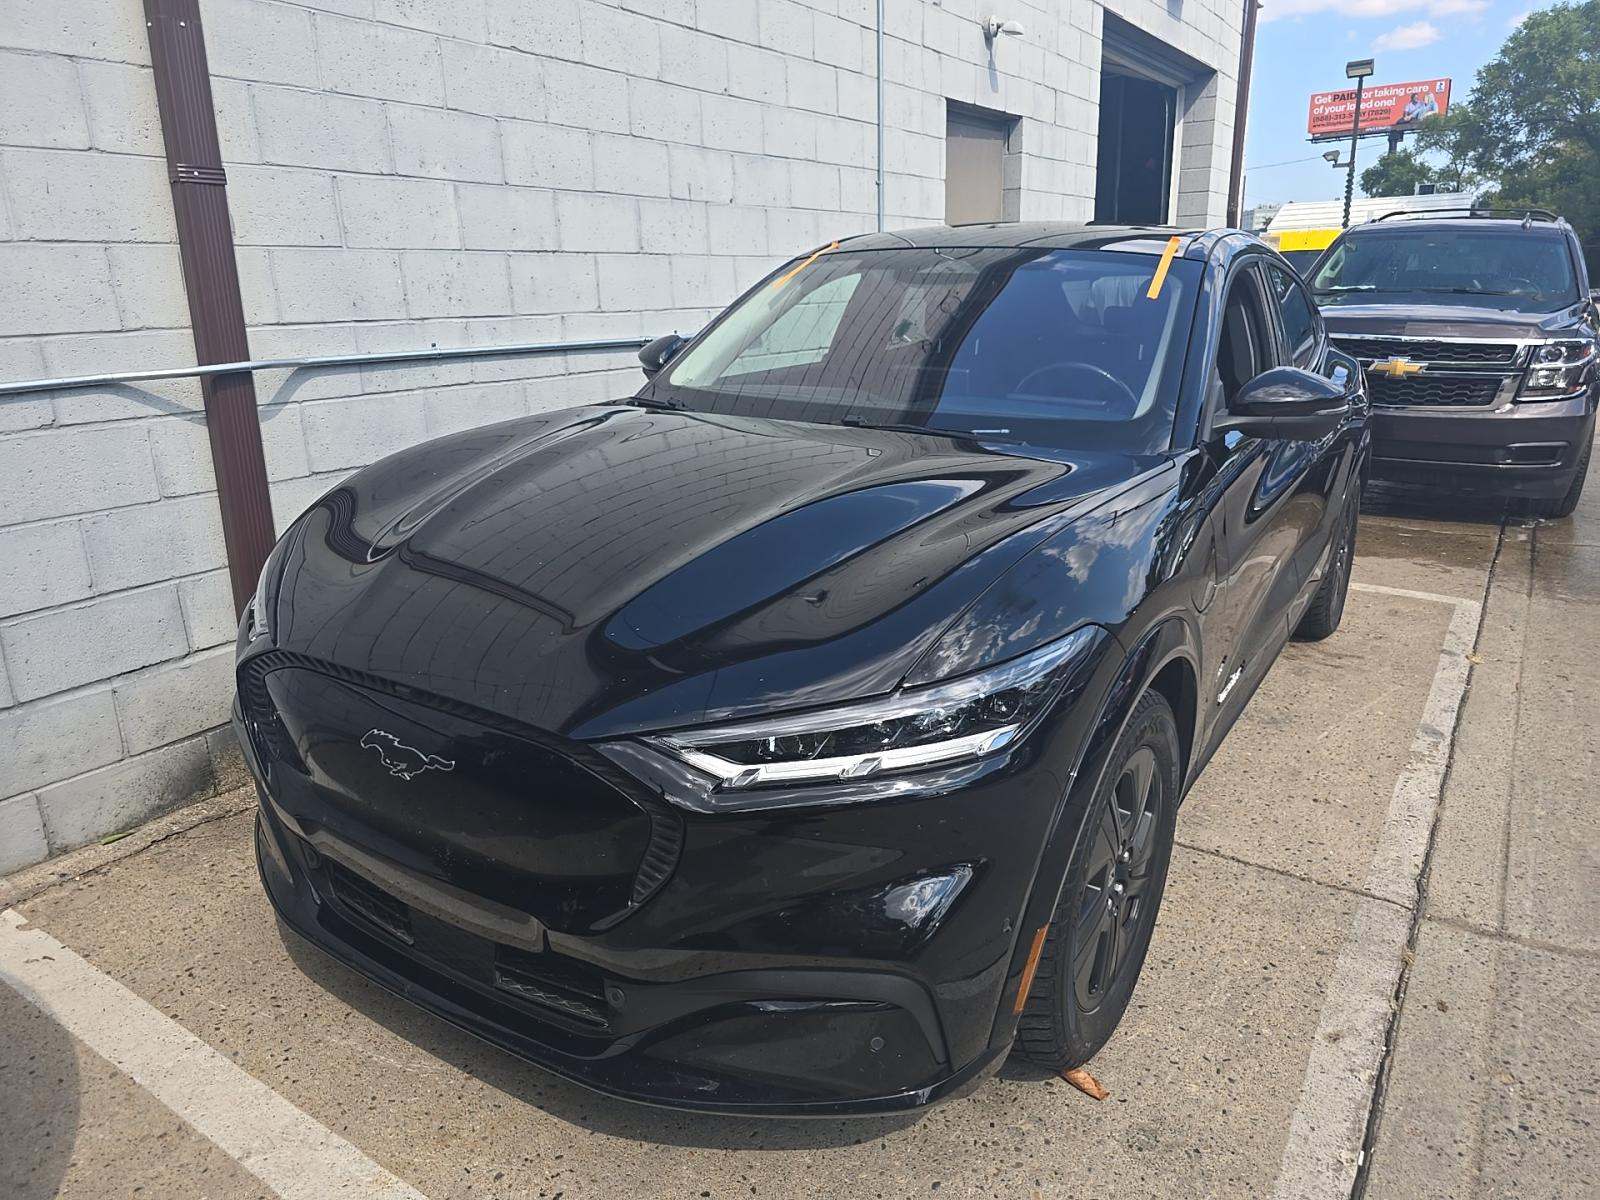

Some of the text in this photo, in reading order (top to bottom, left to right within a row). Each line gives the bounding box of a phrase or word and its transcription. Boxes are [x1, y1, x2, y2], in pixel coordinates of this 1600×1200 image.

[1314, 85, 1429, 105] Get PAID or taking care
[1313, 97, 1396, 115] of your loed one!
